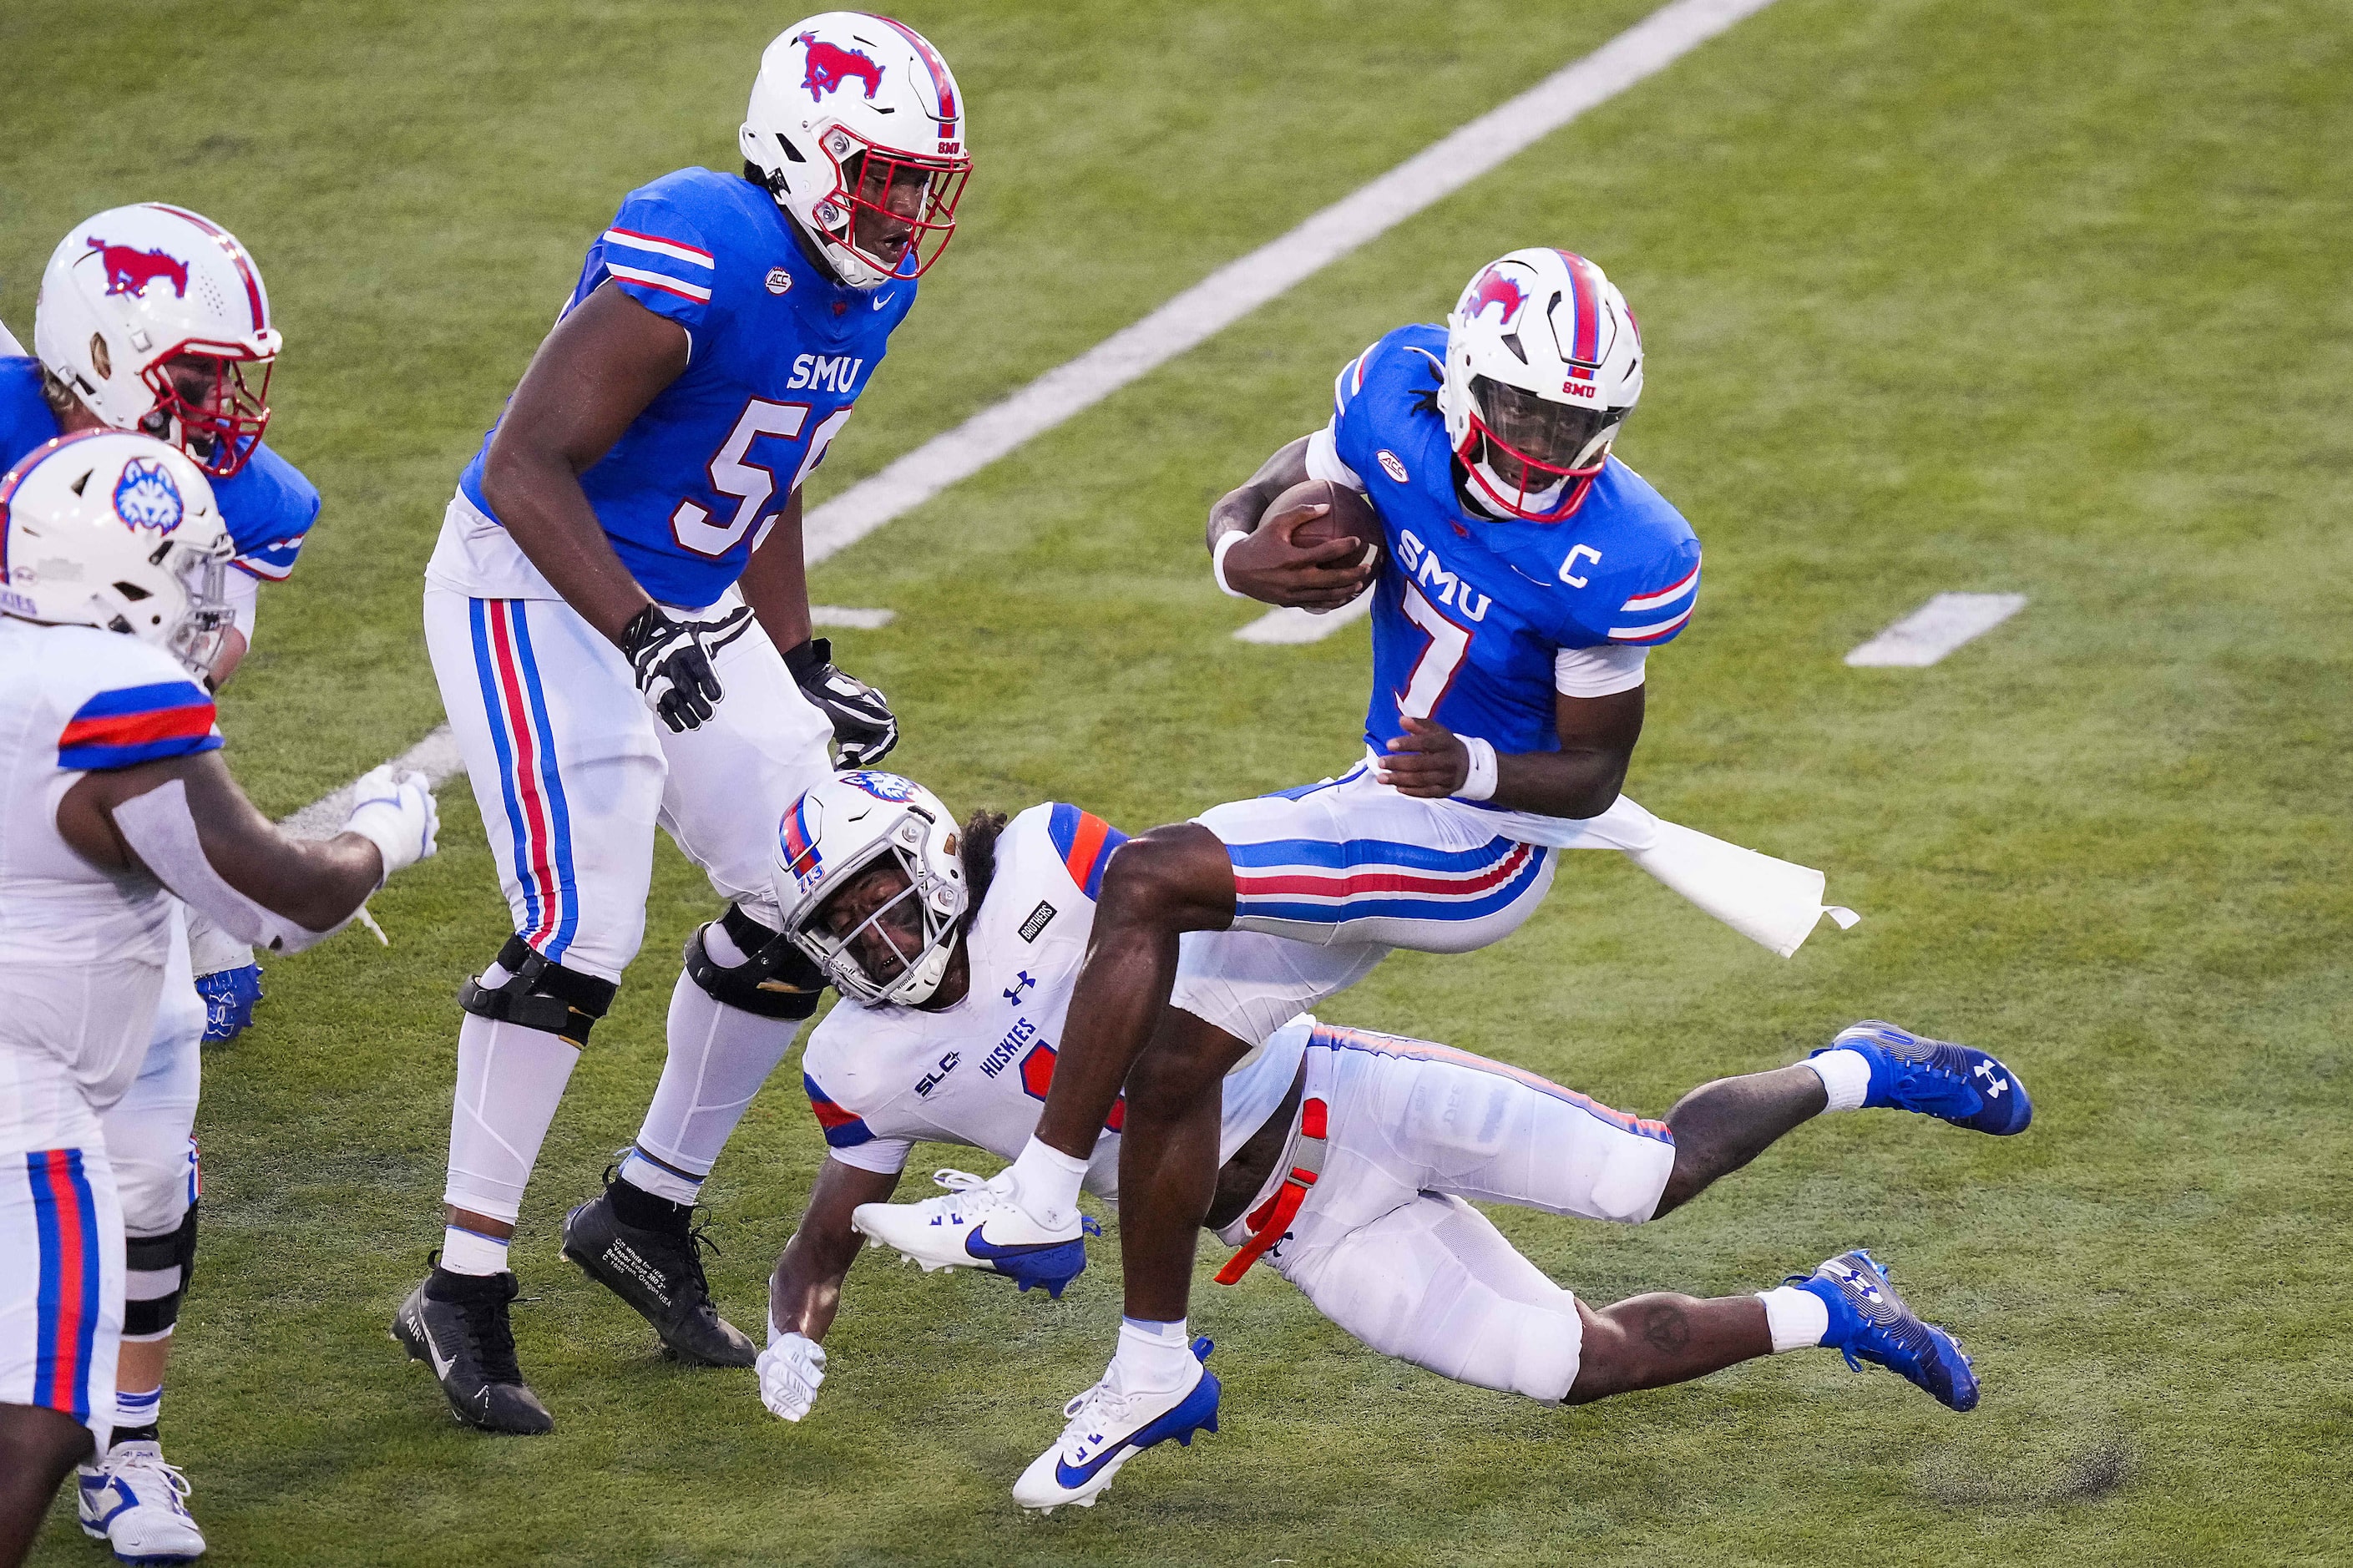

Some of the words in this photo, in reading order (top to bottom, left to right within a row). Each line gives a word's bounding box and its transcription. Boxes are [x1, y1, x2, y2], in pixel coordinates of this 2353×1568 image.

[938, 141, 960, 154] SMU
[768, 273, 789, 286] ACC
[787, 353, 863, 393] SMU
[1562, 381, 1596, 398] SMU
[1381, 457, 1404, 477] ACC
[1398, 529, 1492, 622] SMU
[1558, 544, 1602, 589] C
[1393, 574, 1475, 720] 7
[797, 864, 825, 895] 713
[1020, 903, 1054, 940] BROTHERS
[979, 1016, 1036, 1080] HUSKIES
[914, 1050, 961, 1099] SLC
[638, 1274, 660, 1295] Oregon
[658, 1292, 672, 1308] USA
